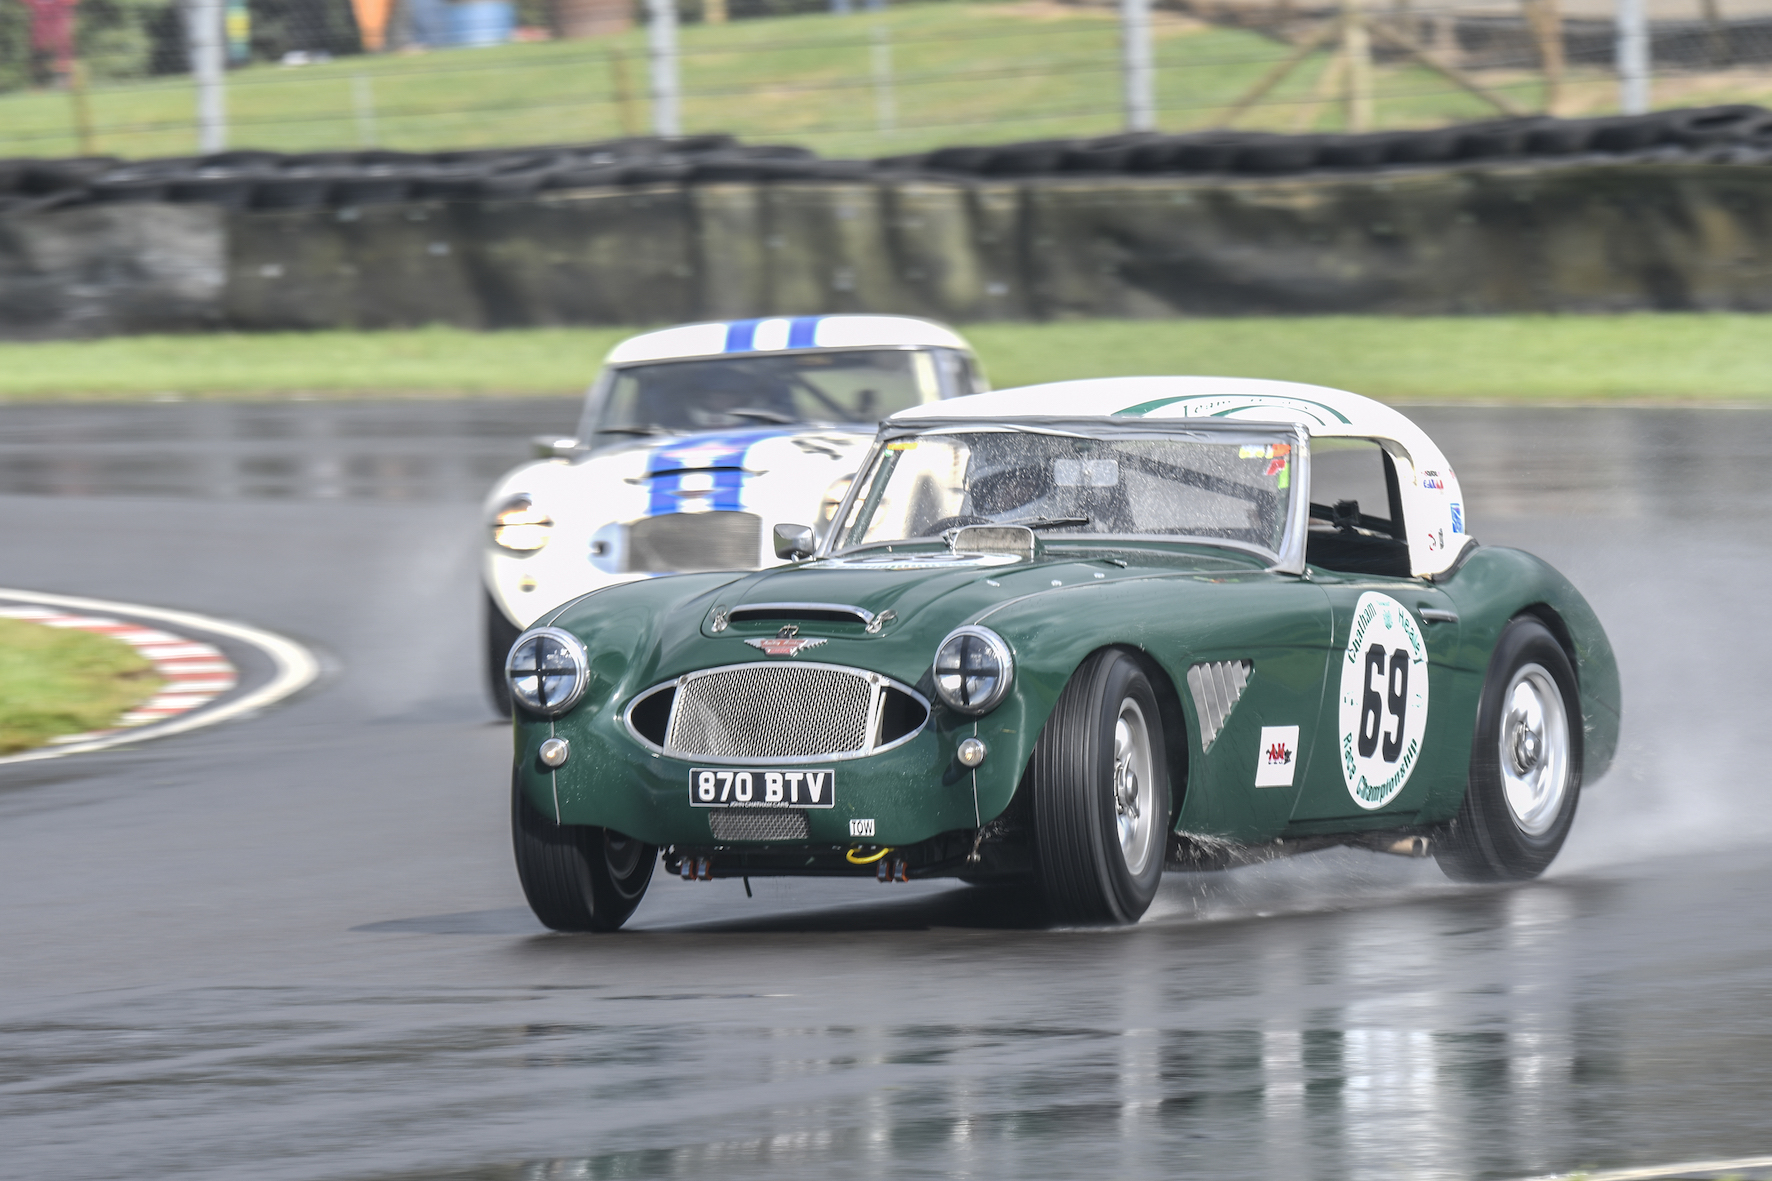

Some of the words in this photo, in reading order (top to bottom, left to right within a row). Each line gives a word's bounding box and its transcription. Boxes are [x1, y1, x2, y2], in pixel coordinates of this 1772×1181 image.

[1347, 602, 1377, 665] Chatham
[1397, 607, 1425, 665] Healey
[1357, 642, 1410, 764] 69
[698, 771, 753, 802] 870
[764, 772, 825, 803] BTV
[1343, 731, 1357, 780] Race
[1356, 738, 1419, 805] Championship
[851, 820, 873, 836] TOW
